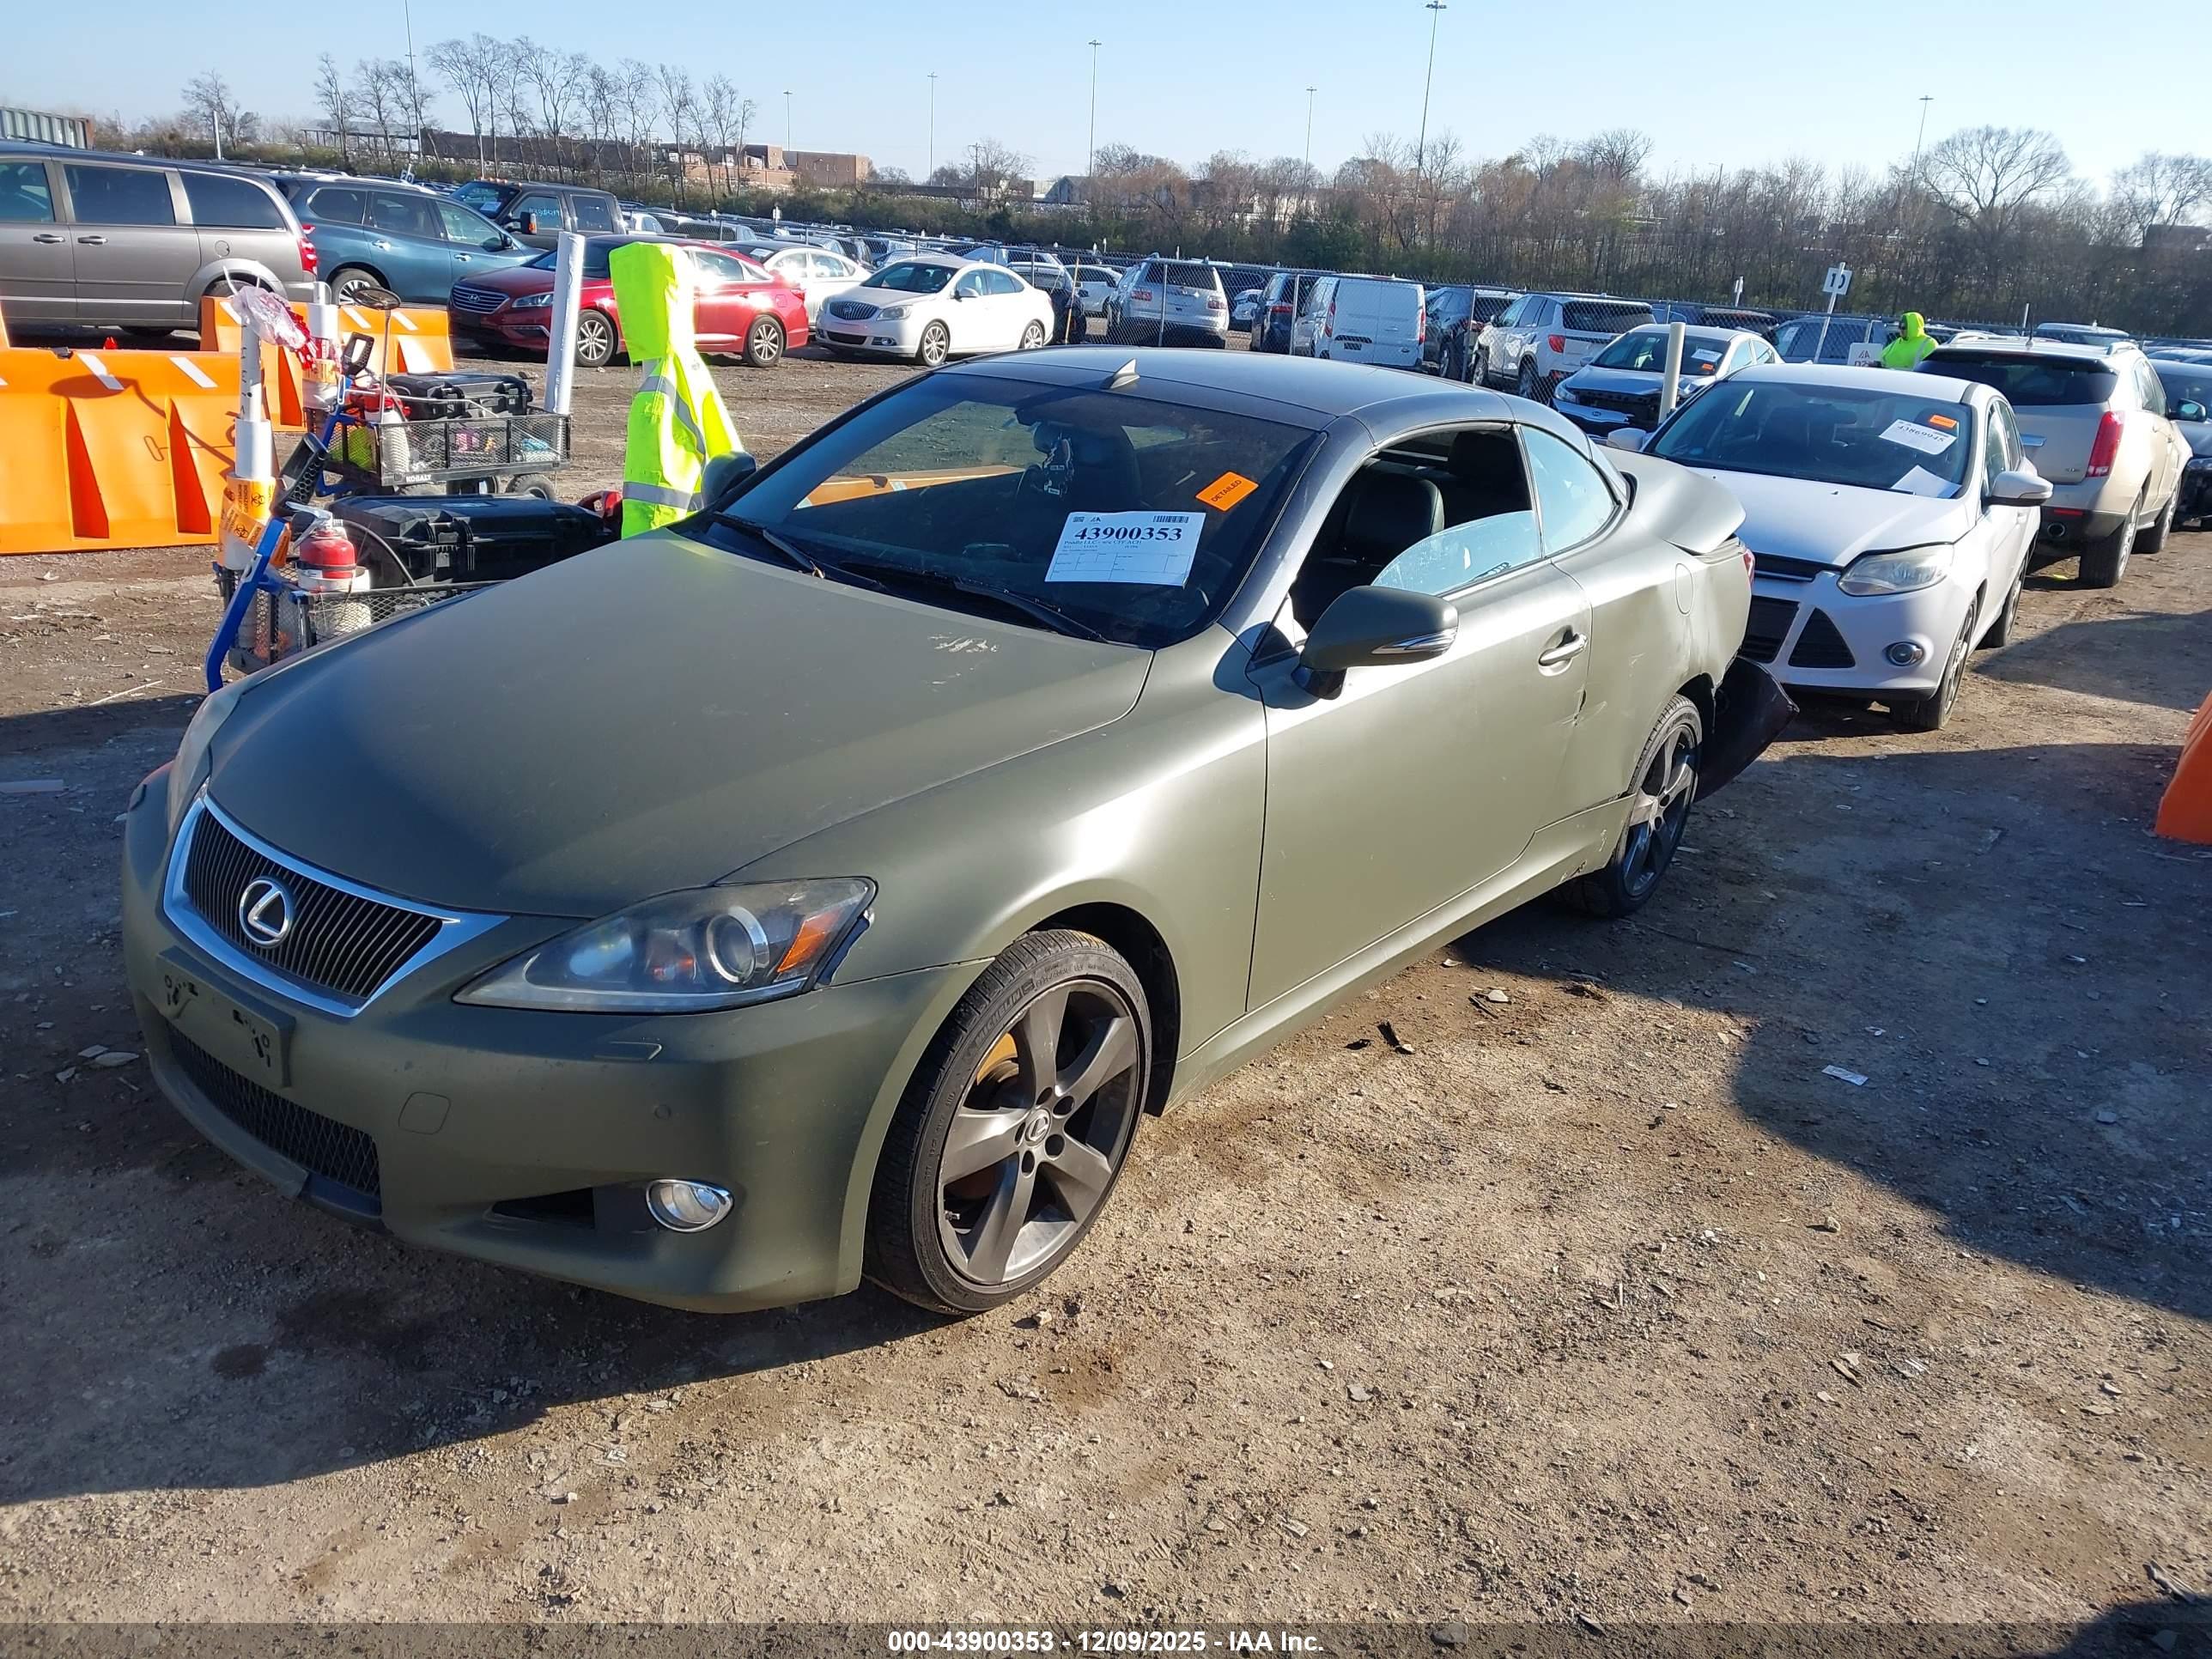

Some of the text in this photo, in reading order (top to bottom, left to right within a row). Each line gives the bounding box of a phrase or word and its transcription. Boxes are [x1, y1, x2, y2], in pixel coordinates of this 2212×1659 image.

[403, 172, 412, 183] 20
[1211, 479, 1243, 502] DETAILED
[1074, 526, 1182, 541] 43900353
